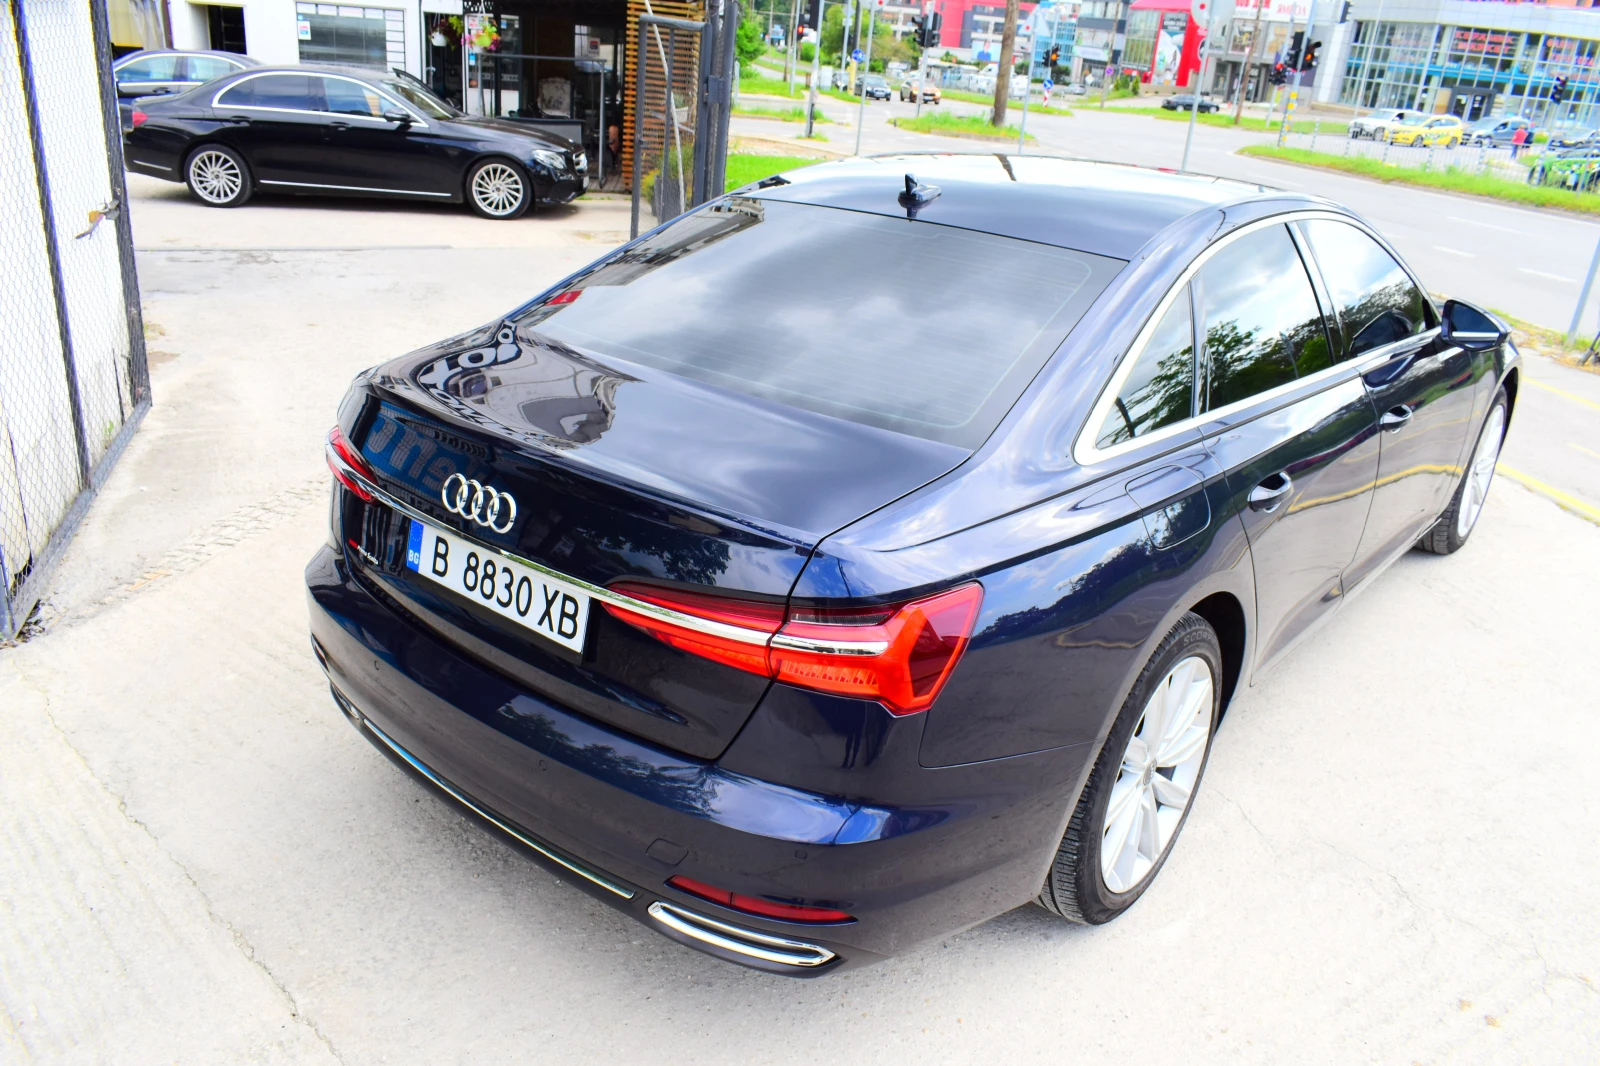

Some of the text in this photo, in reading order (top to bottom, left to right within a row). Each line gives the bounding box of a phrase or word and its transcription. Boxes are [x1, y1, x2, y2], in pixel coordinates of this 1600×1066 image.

[408, 550, 419, 565] BG
[432, 535, 579, 640] B 8830 XB
